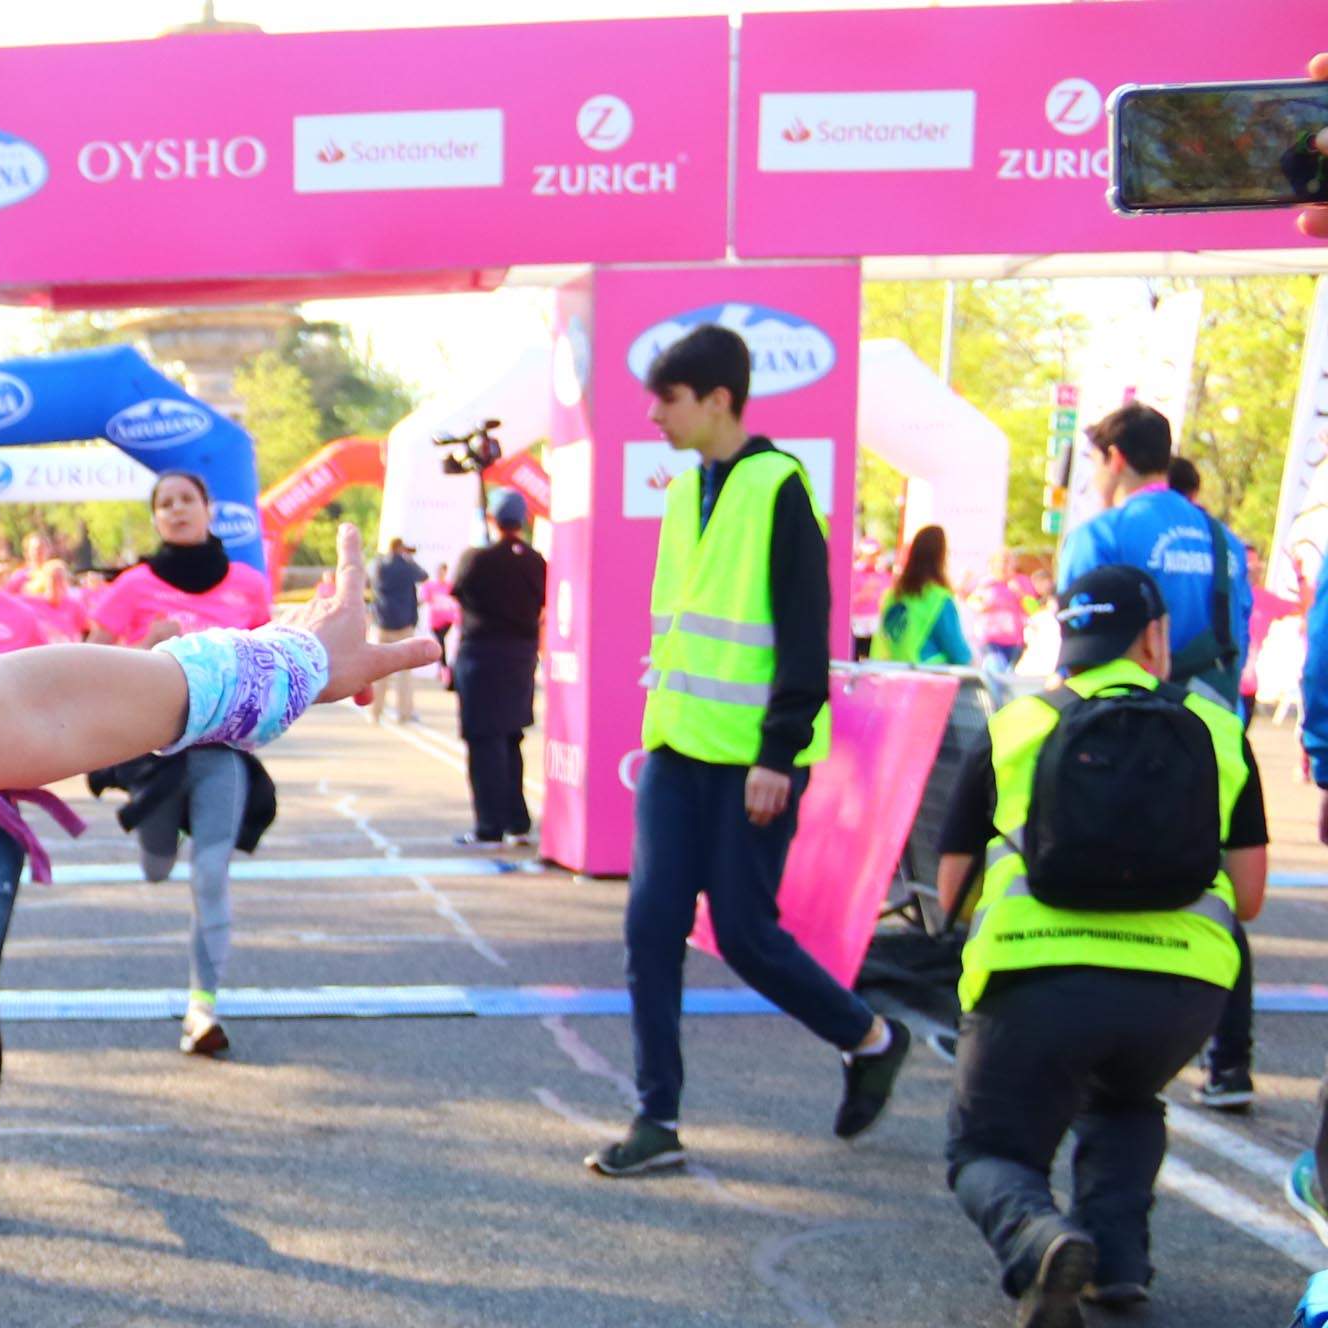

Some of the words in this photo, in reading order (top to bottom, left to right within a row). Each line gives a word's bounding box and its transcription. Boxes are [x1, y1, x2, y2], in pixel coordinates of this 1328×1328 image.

[817, 121, 951, 144] Santander
[77, 135, 267, 183] OYSHO
[350, 140, 479, 164] Santander
[997, 149, 1109, 181] ZURIC
[532, 163, 677, 196] ZURICH
[24, 465, 135, 488] ZURICH
